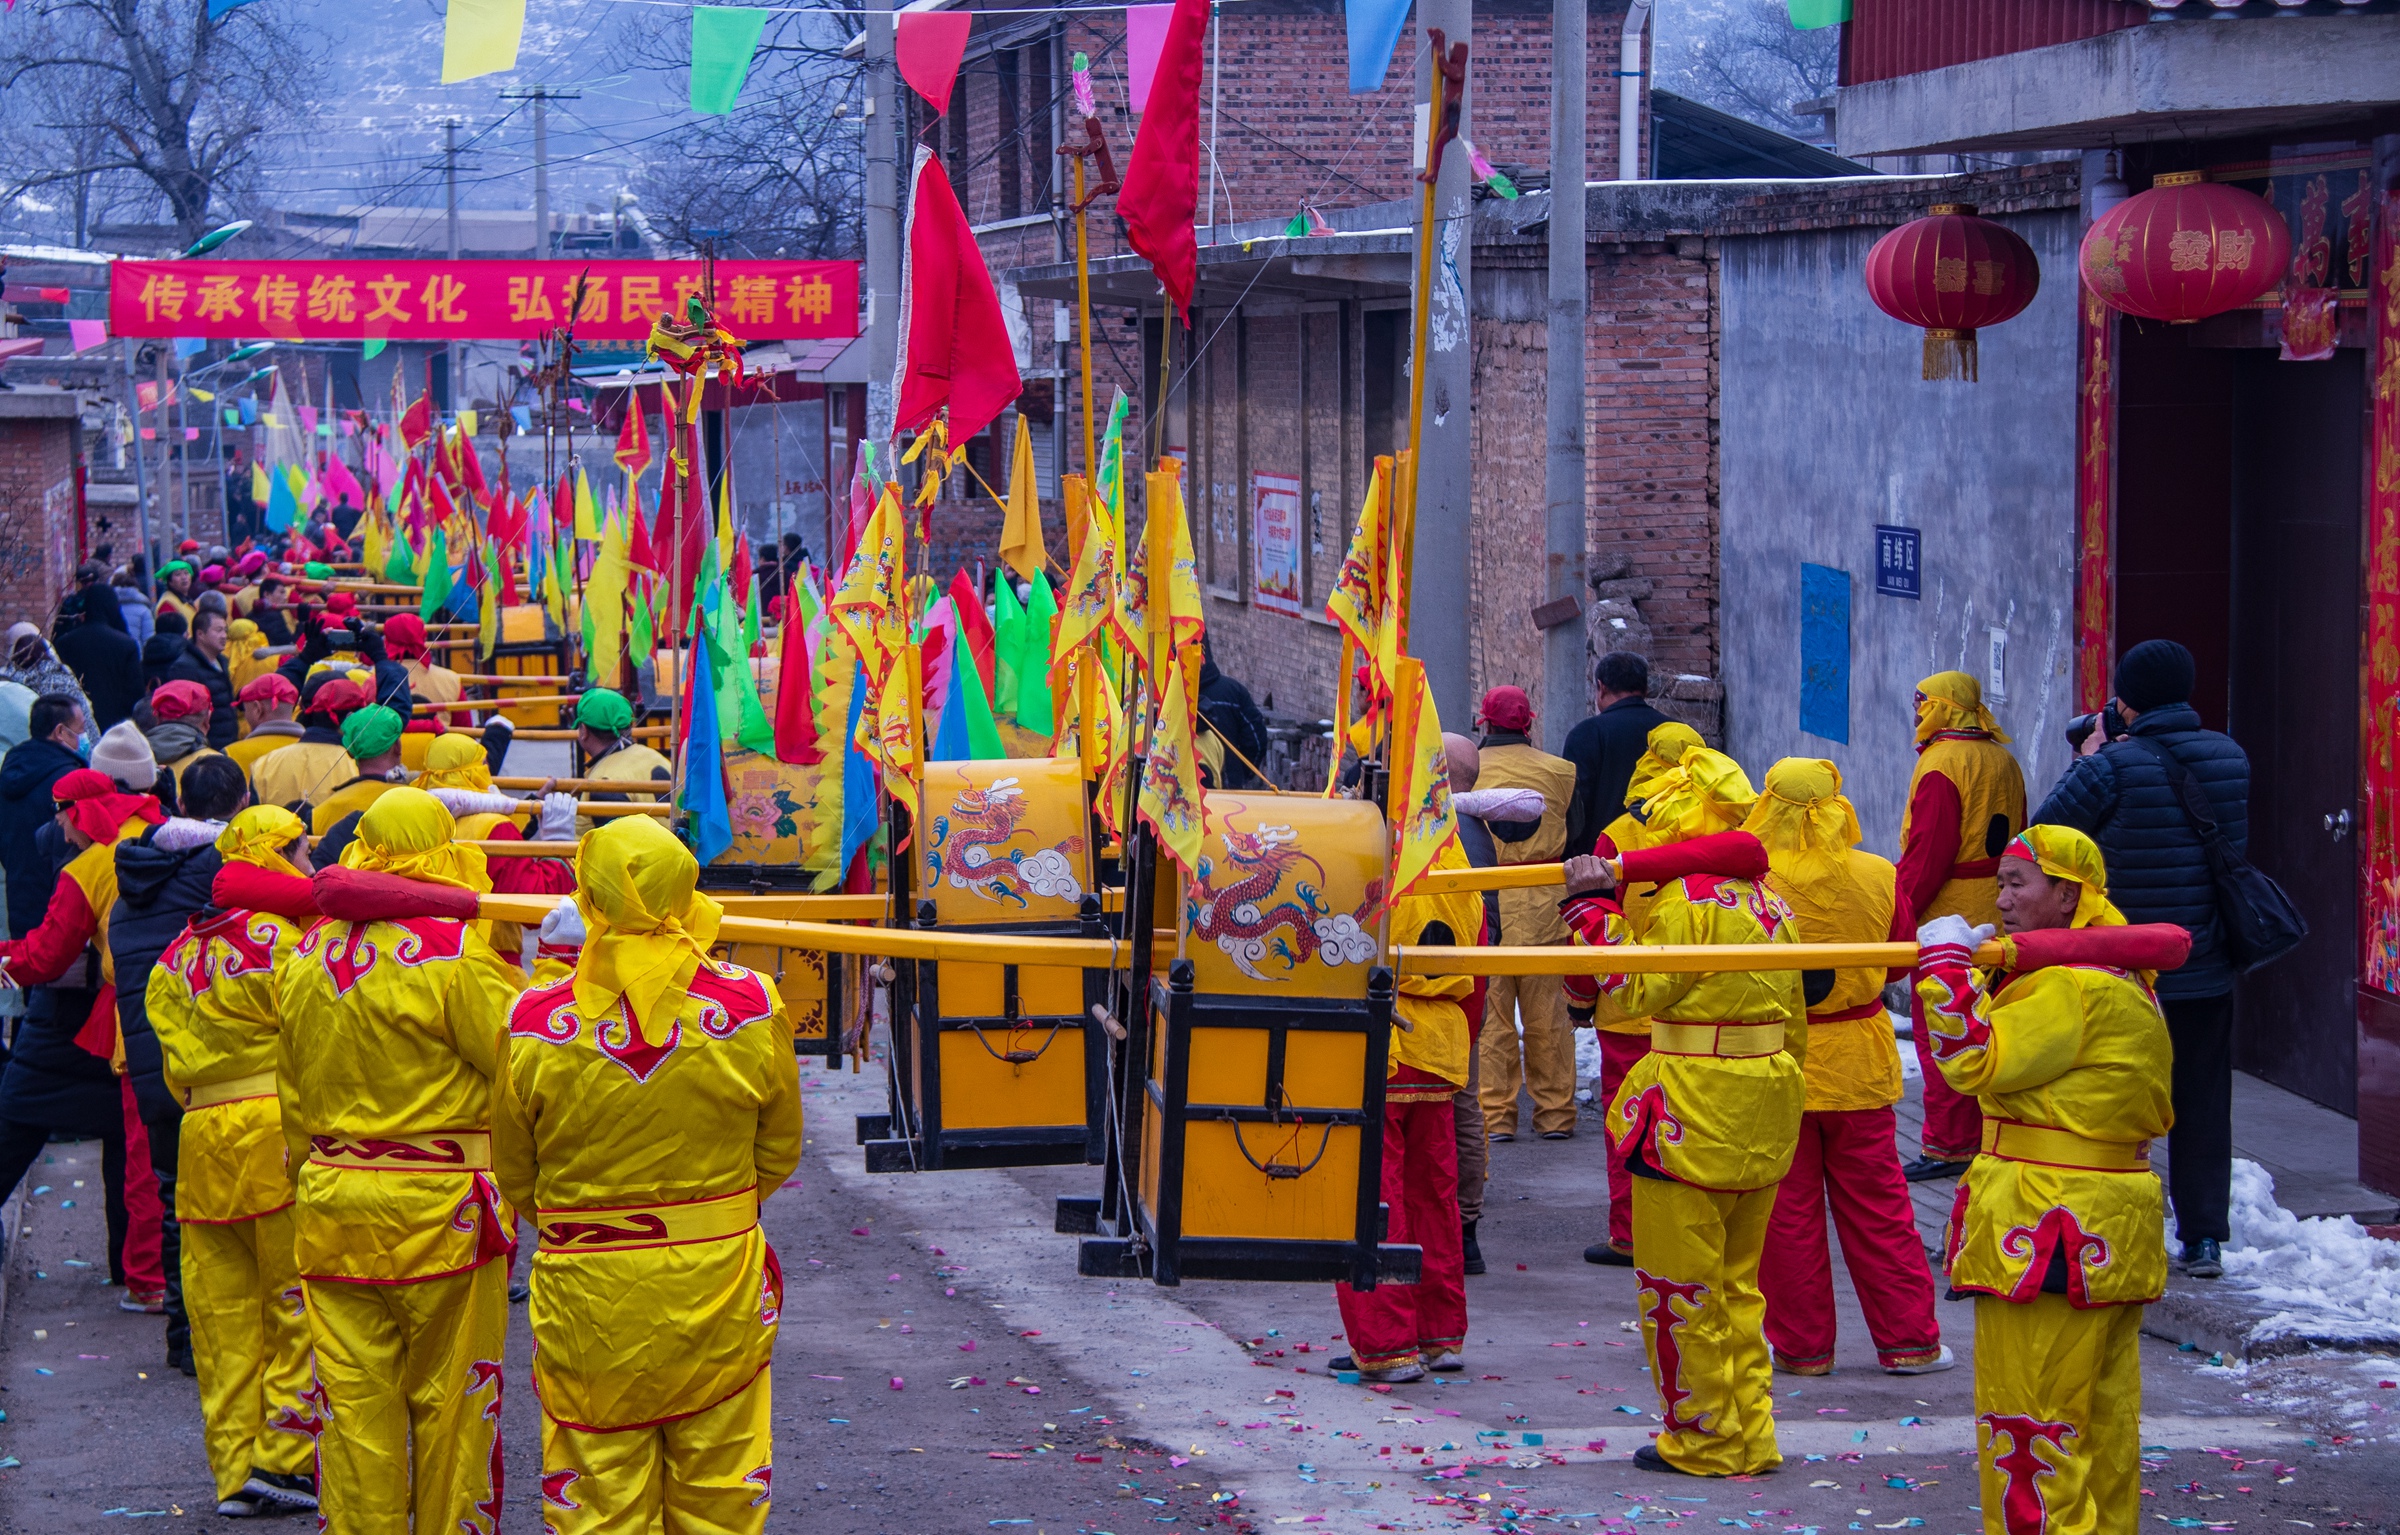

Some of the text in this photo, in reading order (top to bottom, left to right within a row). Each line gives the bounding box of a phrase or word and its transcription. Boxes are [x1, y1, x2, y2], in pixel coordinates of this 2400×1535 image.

[2169, 229, 2255, 271] 發財
[2263, 169, 2373, 288] 萬事
[139, 273, 468, 324] 传承传统文化
[1933, 257, 2005, 295] 恭喜
